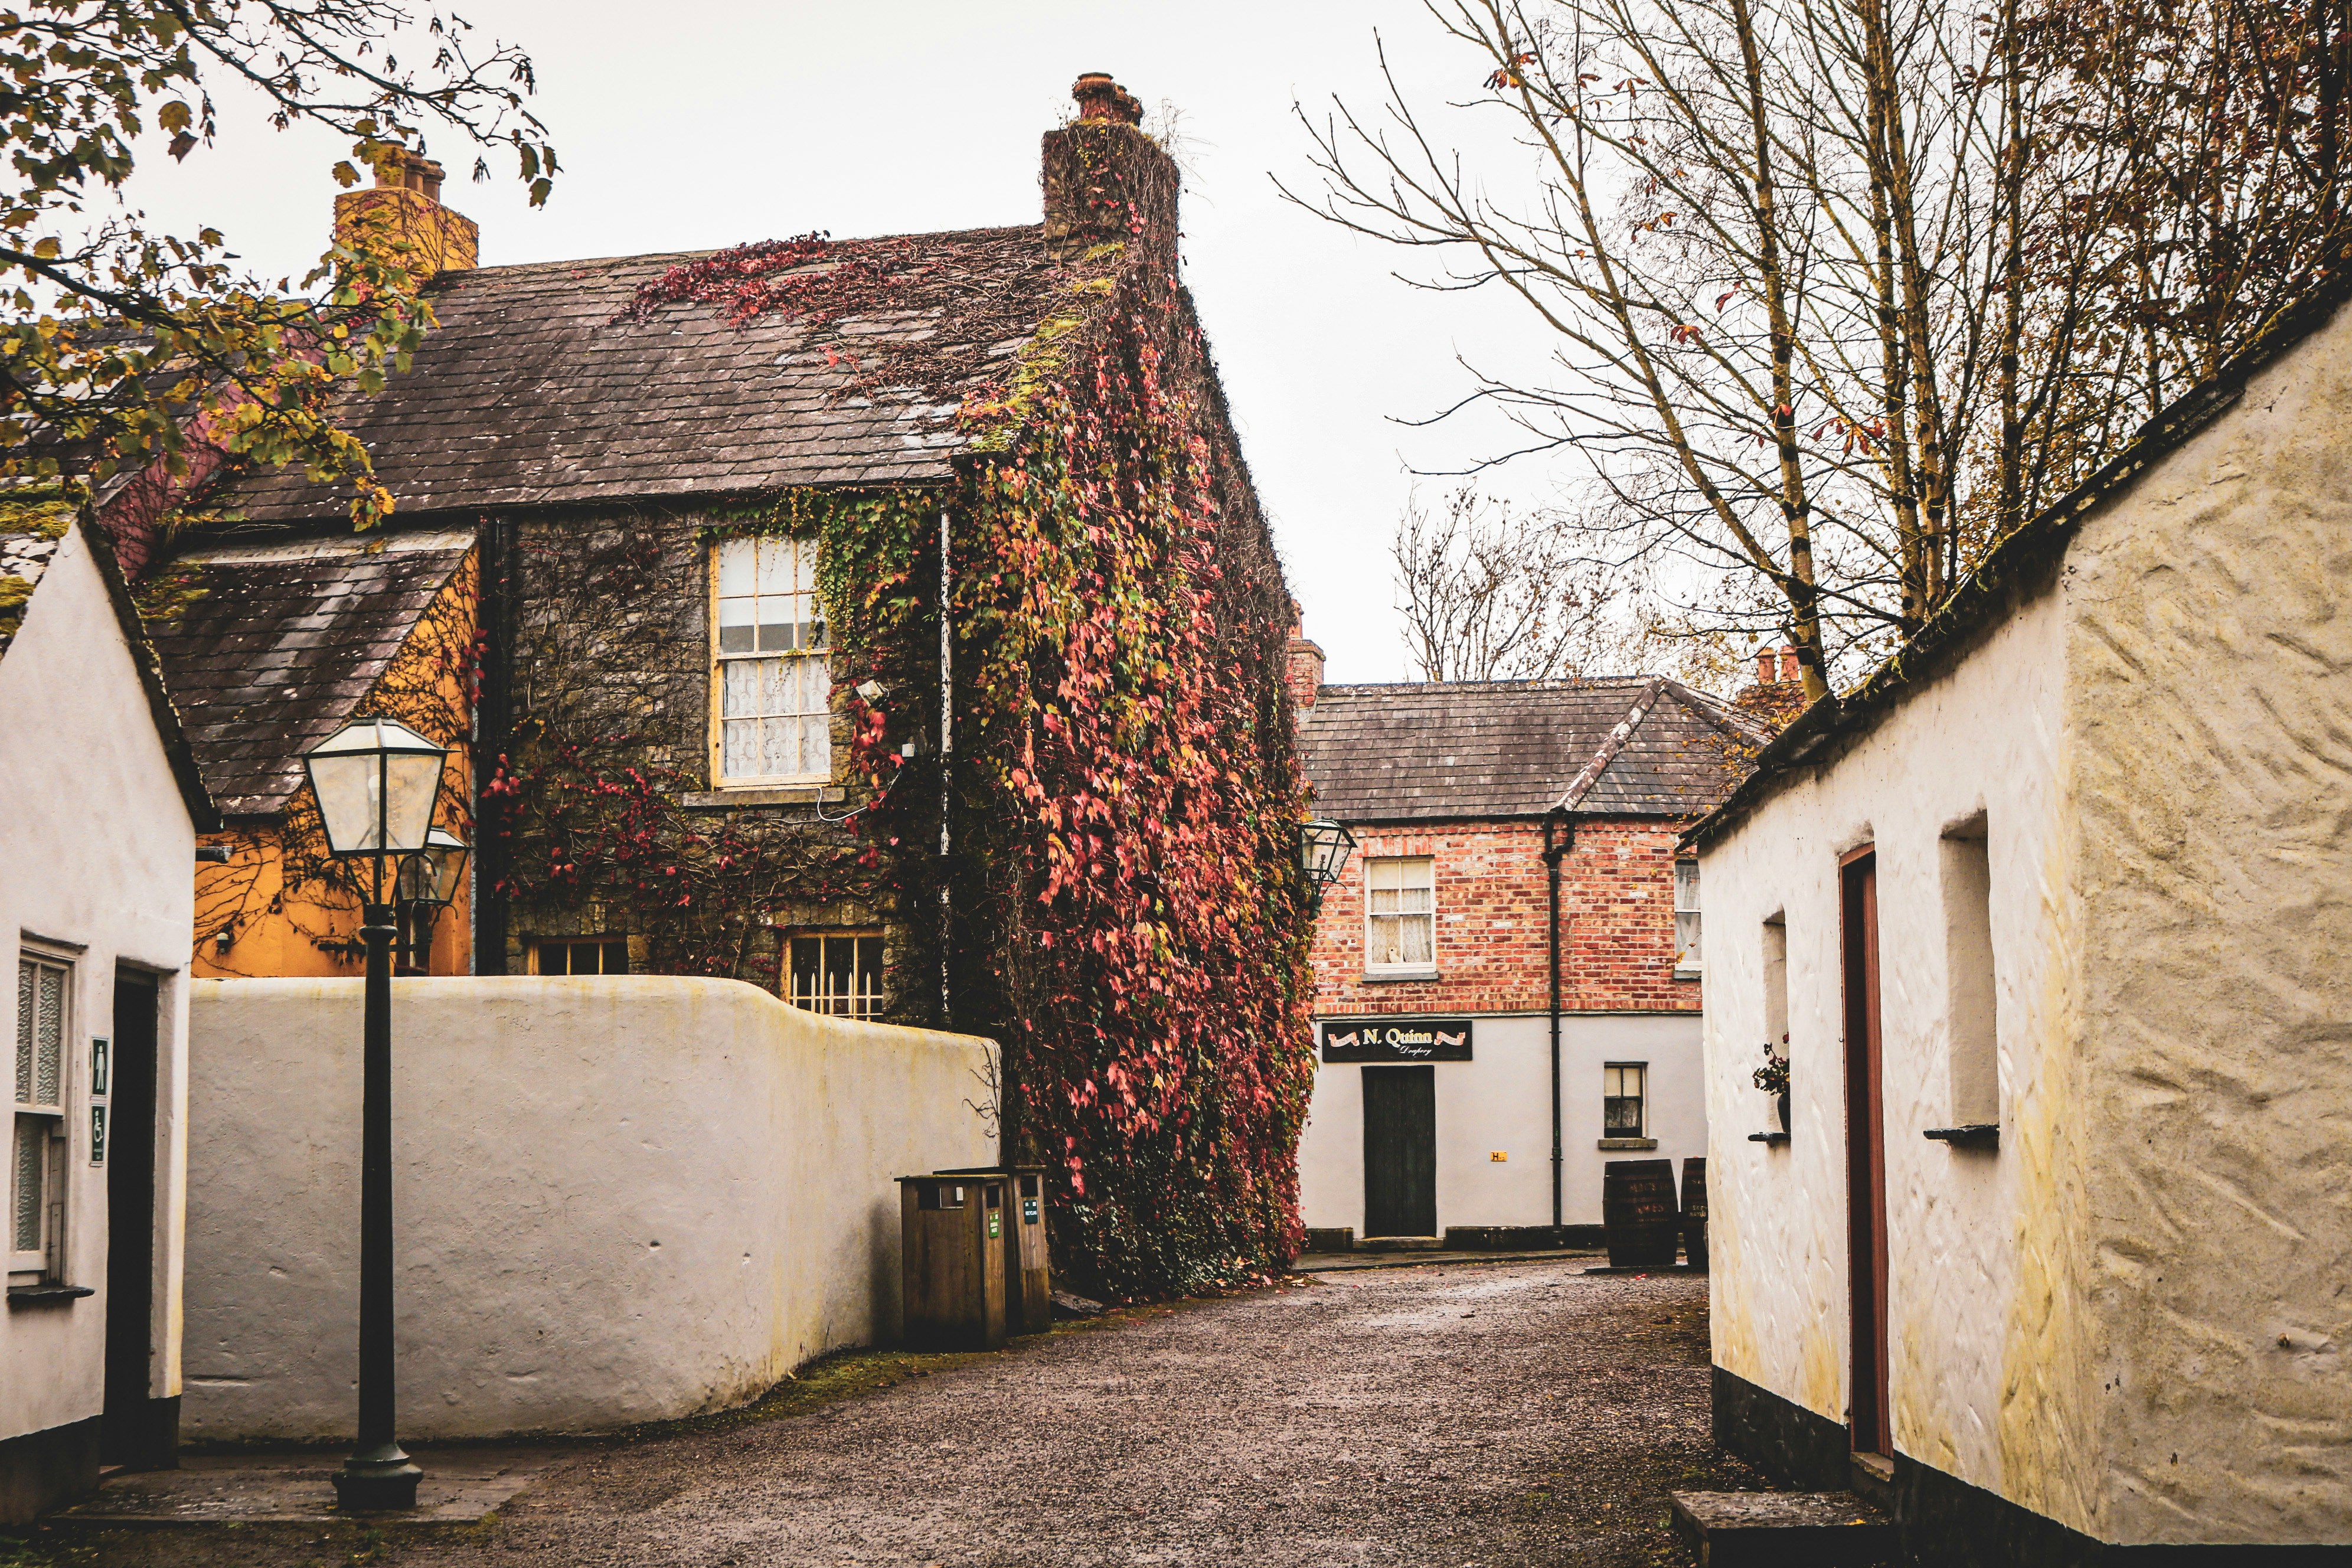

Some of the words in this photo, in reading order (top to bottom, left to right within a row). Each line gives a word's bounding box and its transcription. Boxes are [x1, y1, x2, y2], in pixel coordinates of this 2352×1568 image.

[1363, 1028, 1382, 1044] N.
[1386, 1028, 1433, 1048] Quinn
[1399, 1046, 1432, 1056] Drapery
